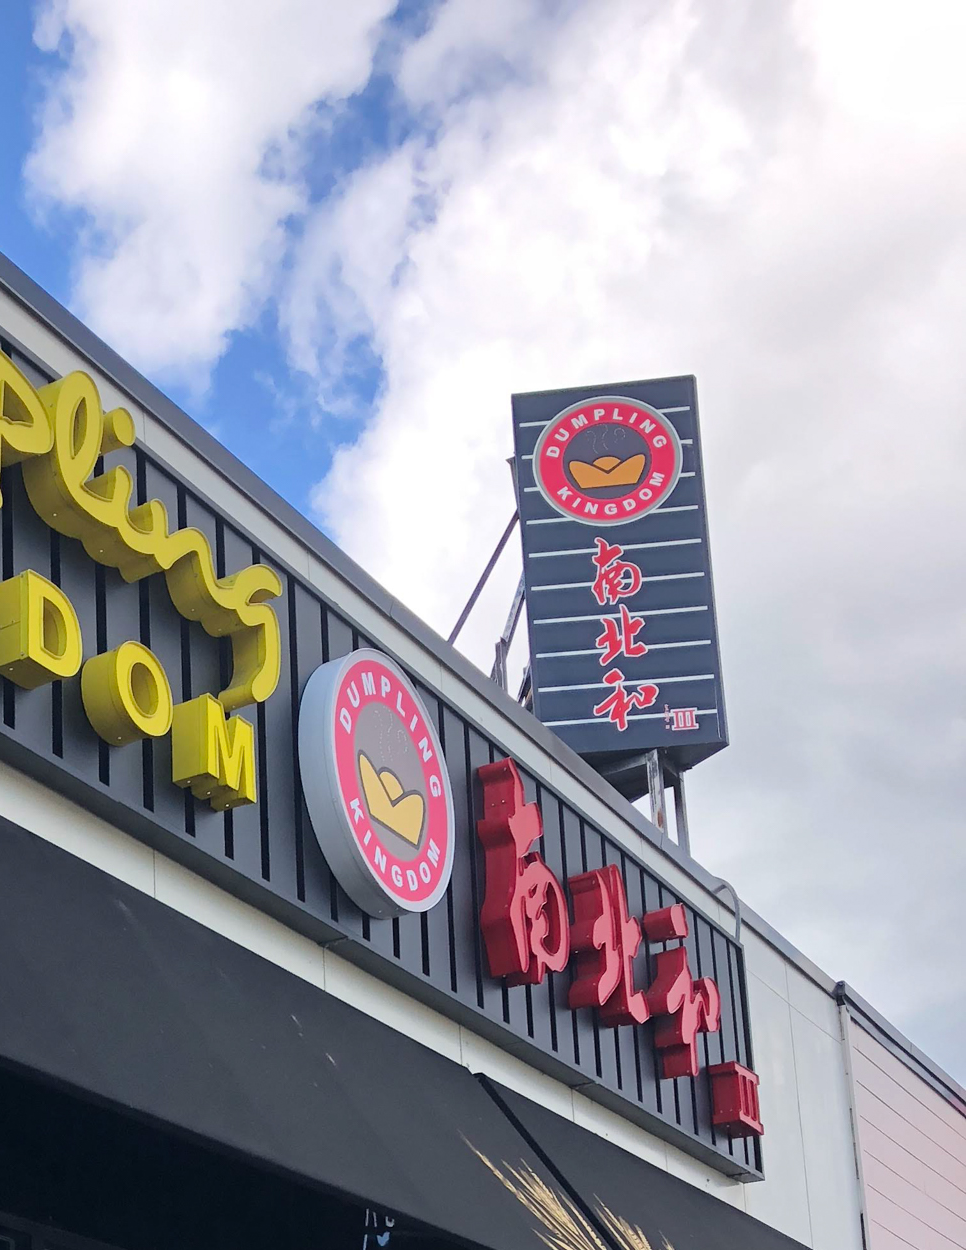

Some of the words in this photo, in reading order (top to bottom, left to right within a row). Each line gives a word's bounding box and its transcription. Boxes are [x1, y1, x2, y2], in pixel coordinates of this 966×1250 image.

[545, 408, 667, 459] DUMPLING
[557, 471, 665, 516] KINGDOM
[591, 536, 660, 732] 南北和
[339, 671, 442, 798] DUMPLING
[349, 797, 442, 892] KINGDOM
[477, 757, 722, 1080] 南北和
